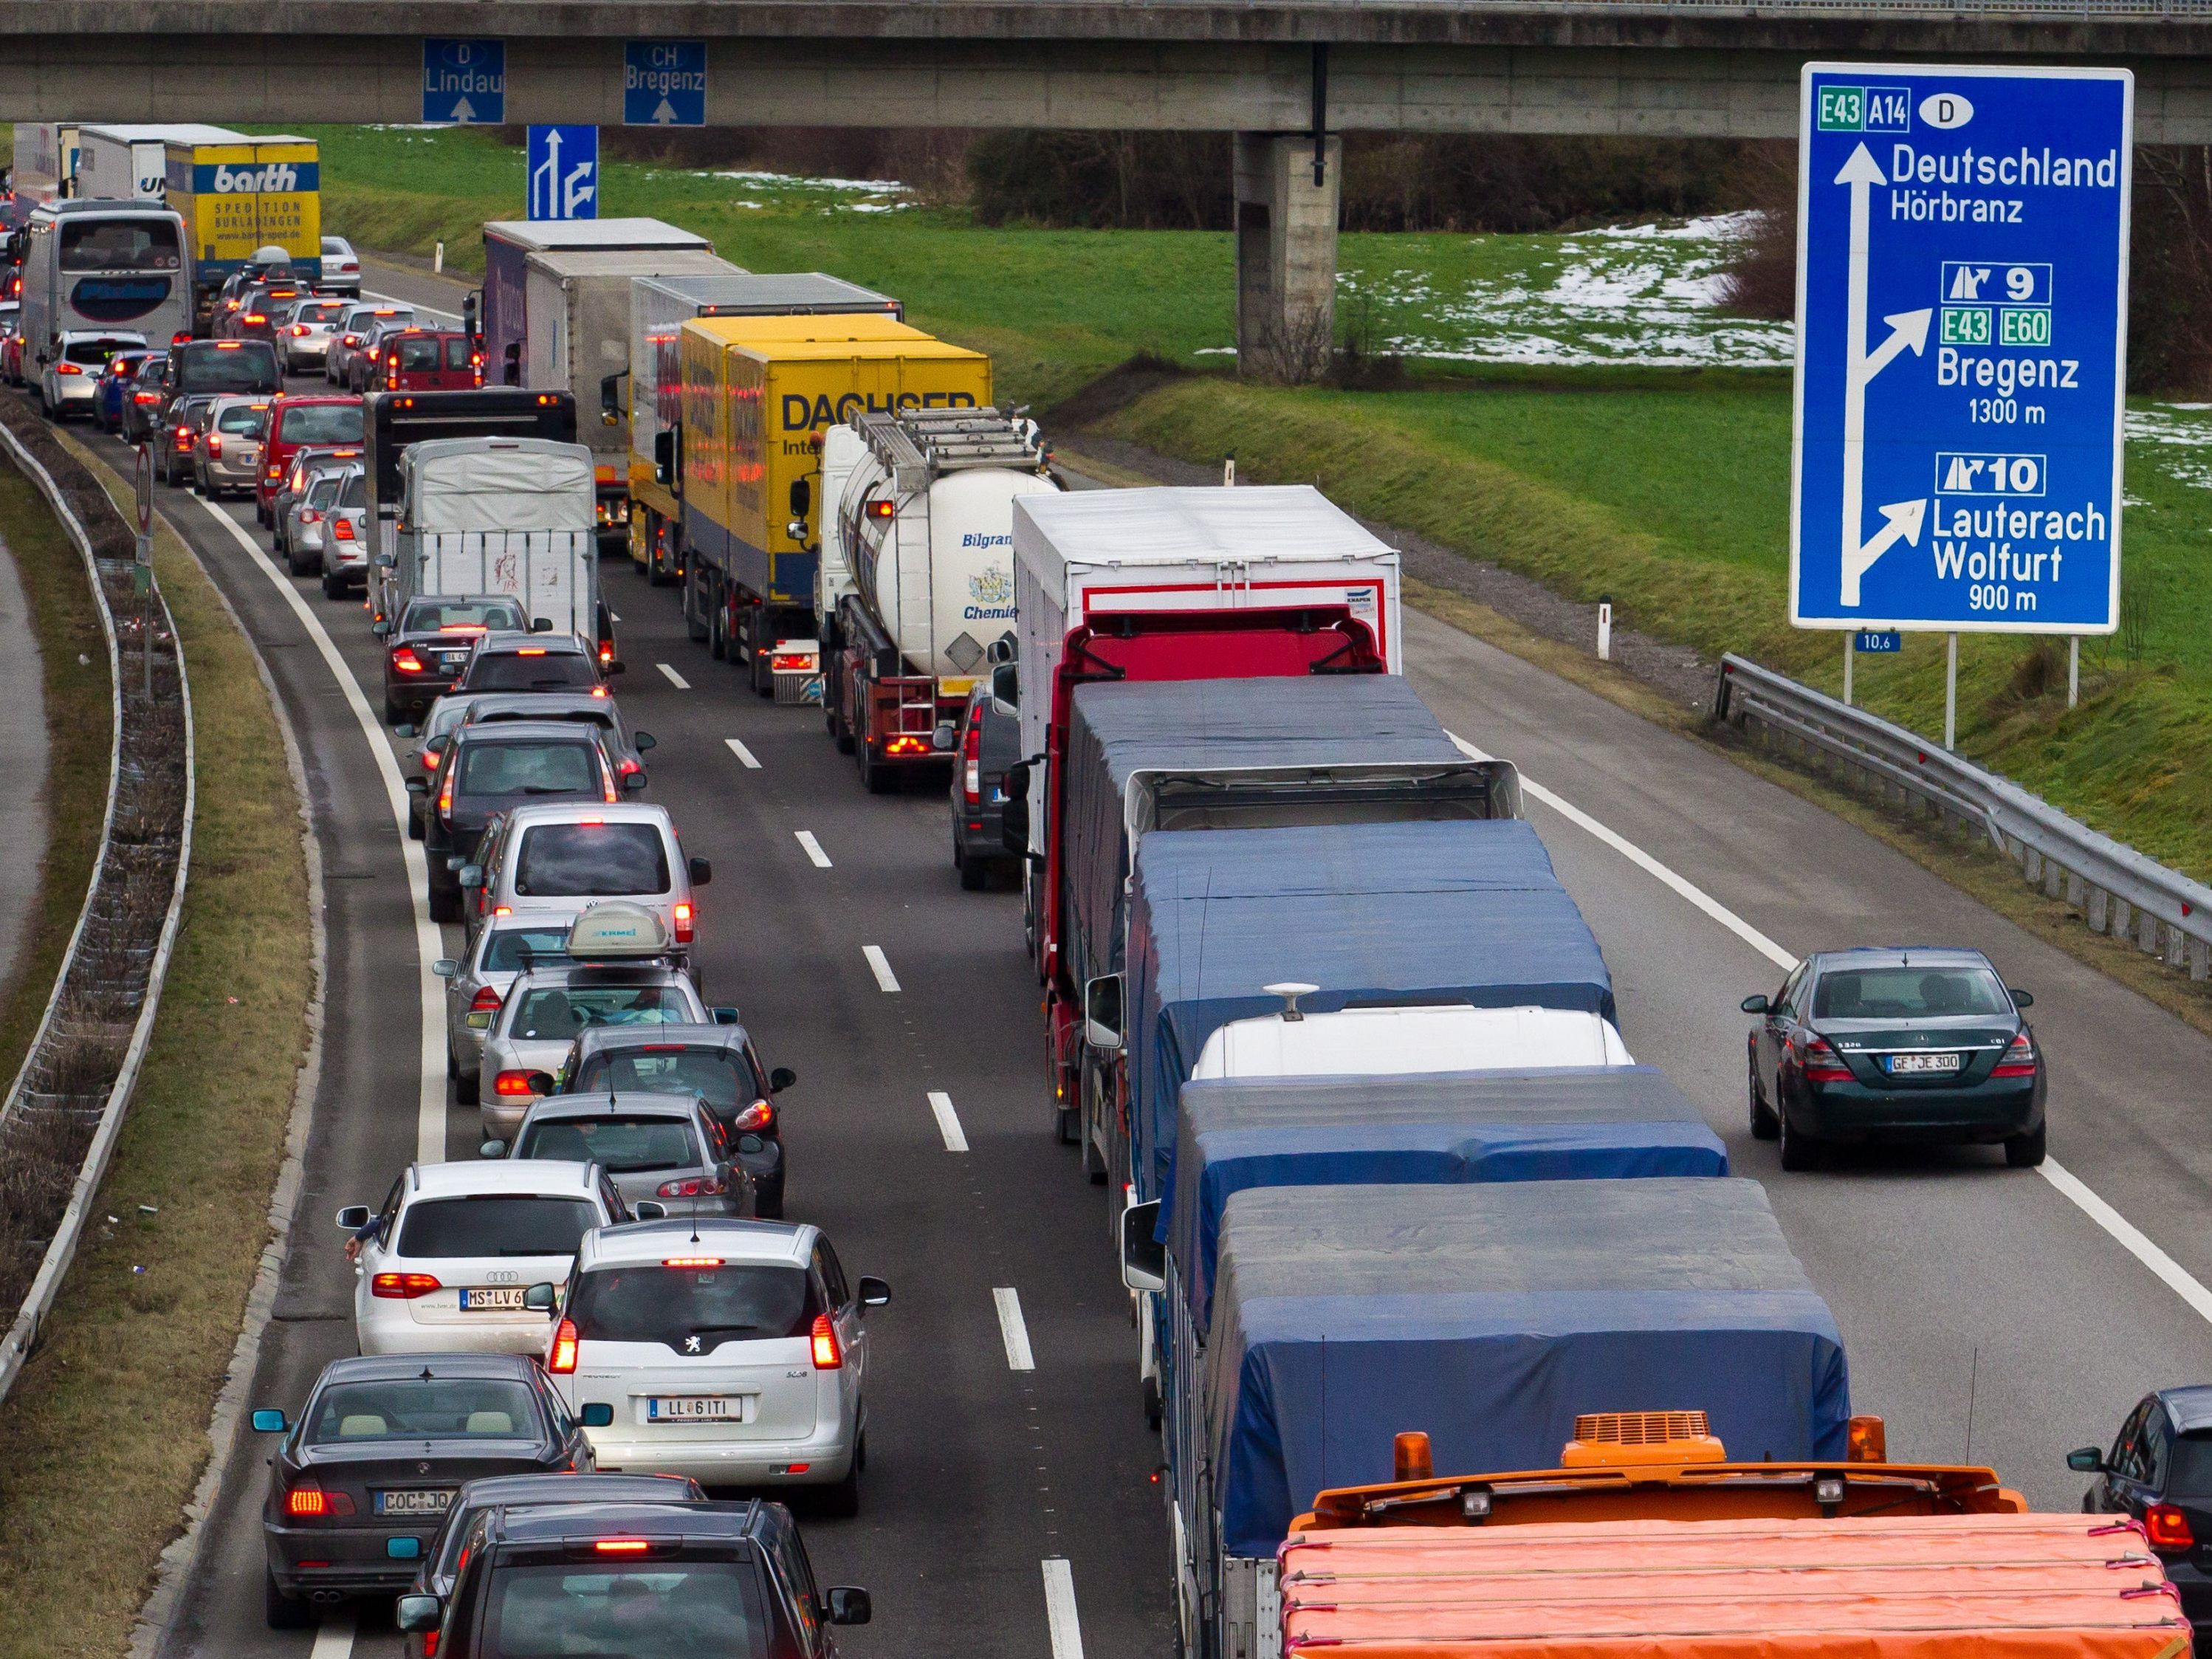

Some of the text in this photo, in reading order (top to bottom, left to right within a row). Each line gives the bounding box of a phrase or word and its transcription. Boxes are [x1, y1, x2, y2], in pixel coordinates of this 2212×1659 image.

[458, 44, 470, 63] D
[652, 46, 677, 66] CH
[425, 68, 503, 93] Lindau
[626, 64, 704, 95] Bregenz
[1821, 93, 1954, 125] E43 A14 D
[1892, 143, 2116, 187] Deutschland
[214, 164, 297, 193] barth
[215, 202, 300, 214] SPEDTION
[1892, 189, 2023, 223] Hörbranz
[2005, 267, 2035, 301] 9
[1943, 311, 2047, 343] E43 E60
[1937, 347, 2079, 397] Bregenz
[1969, 399, 2045, 424] 1300 m
[1988, 458, 2038, 492] 10
[1932, 498, 2105, 540] Lauterach
[1931, 540, 2063, 582] Wolfurt
[1969, 585, 2037, 611] 900 m
[964, 605, 1017, 619] Chemie
[1864, 634, 1890, 650] 10,6
[1893, 1056, 1957, 1070] GE JE 300
[470, 1291, 485, 1305] MS
[495, 1291, 511, 1305] LV
[669, 1401, 684, 1415] LL
[385, 1492, 448, 1510] COC JQ
